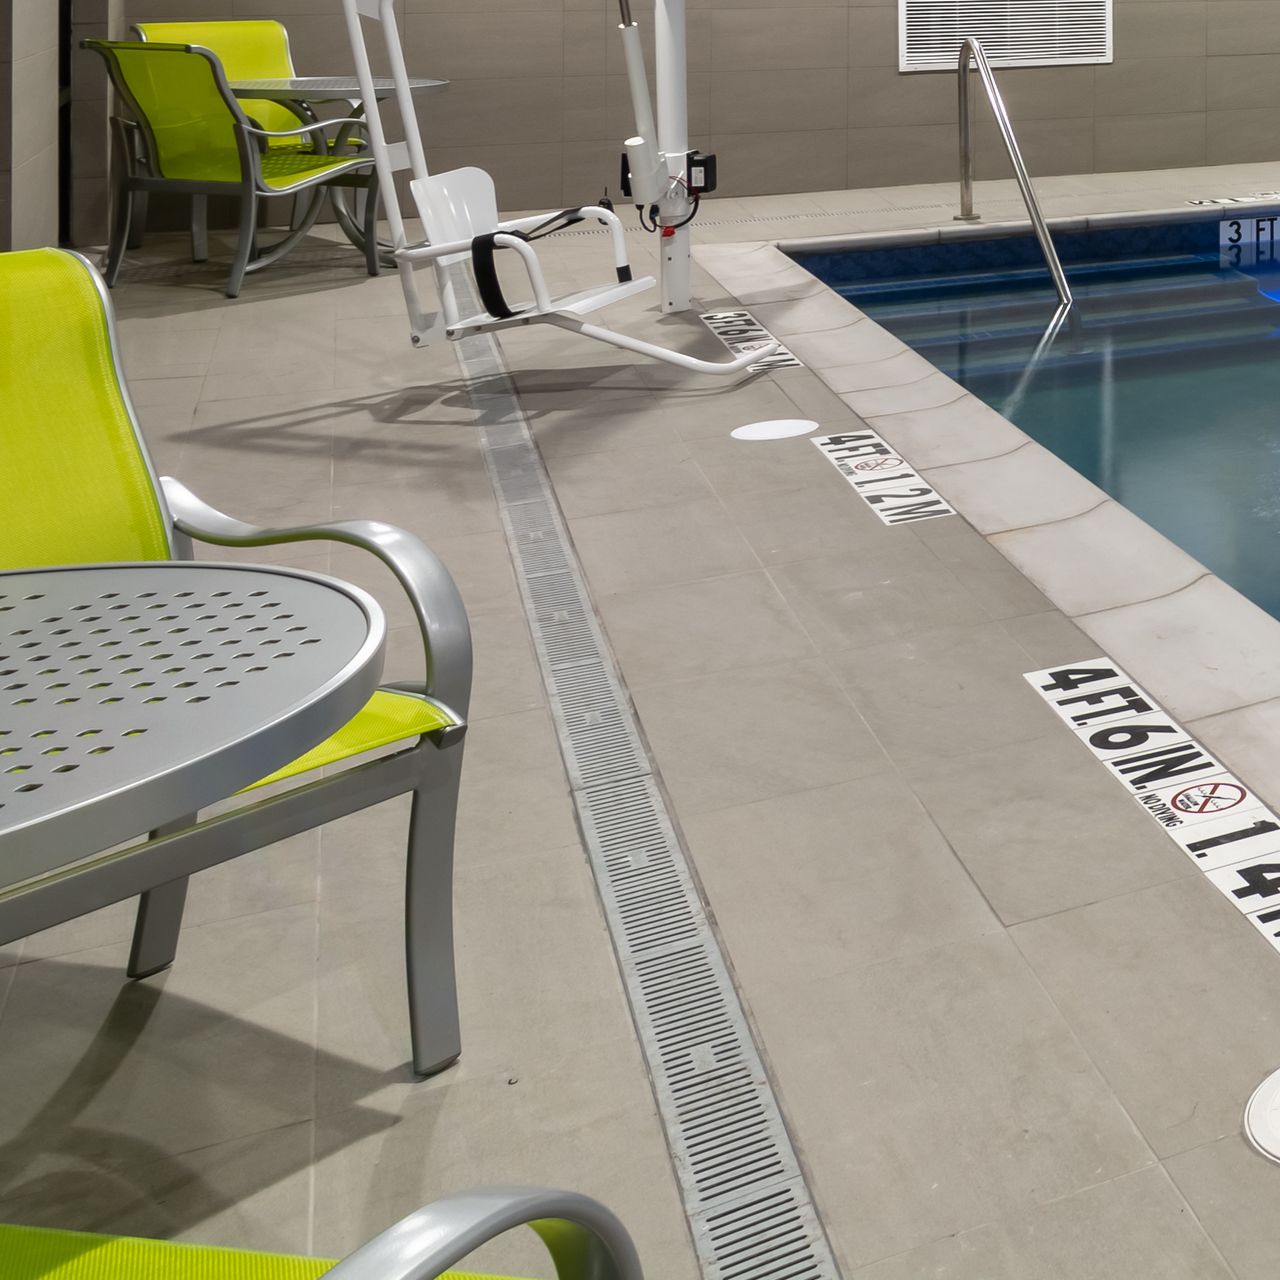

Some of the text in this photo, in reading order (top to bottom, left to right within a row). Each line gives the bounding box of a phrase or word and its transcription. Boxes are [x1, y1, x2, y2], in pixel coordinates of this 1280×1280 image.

[1228, 220, 1242, 243] 3
[1255, 217, 1278, 242] FT
[820, 435, 875, 446] 4
[1041, 667, 1120, 692] 4
[1088, 724, 1178, 750] 6
[1139, 793, 1184, 828] NO DIVING
